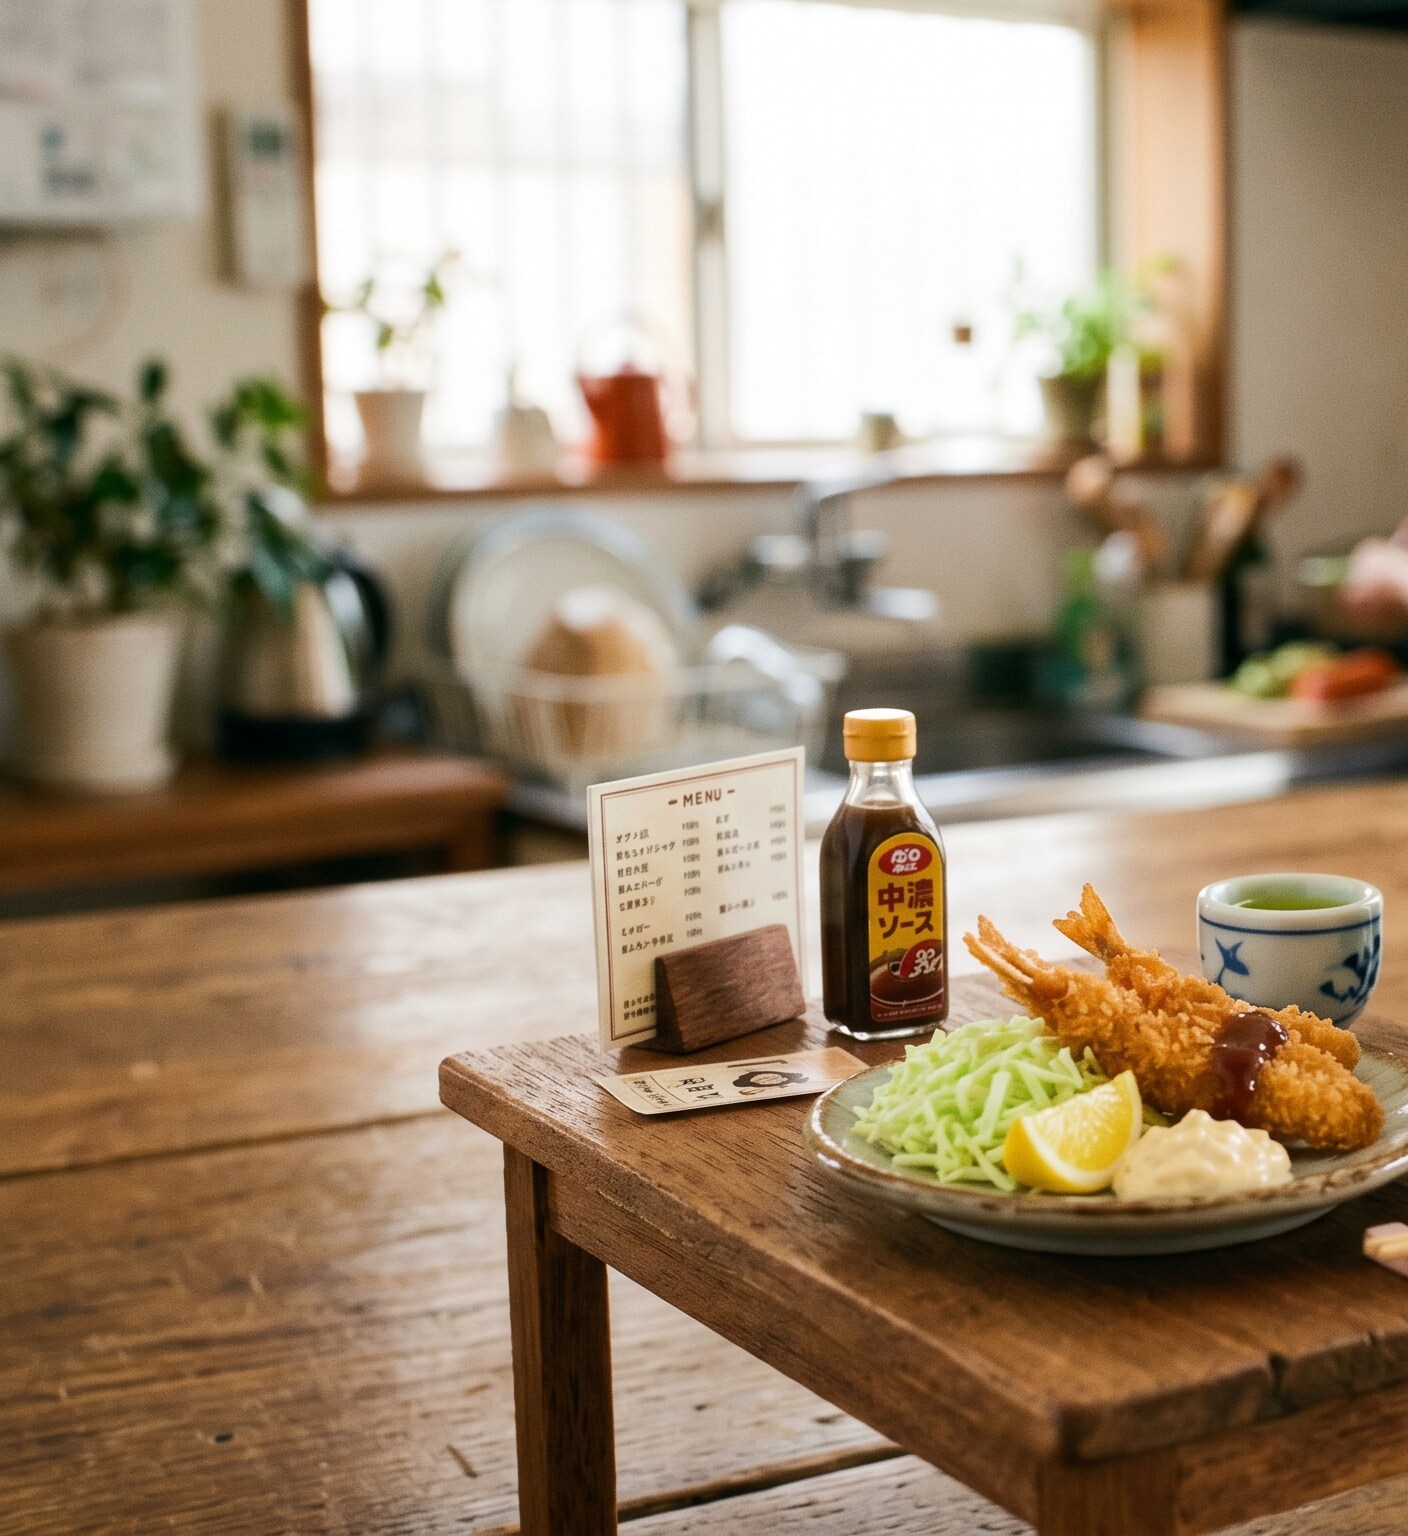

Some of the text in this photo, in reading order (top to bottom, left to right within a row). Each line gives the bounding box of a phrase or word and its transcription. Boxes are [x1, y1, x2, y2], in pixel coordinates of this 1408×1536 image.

[683, 788, 722, 807] MENU
[878, 878, 934, 912] 中濃
[879, 911, 934, 939] ソース
